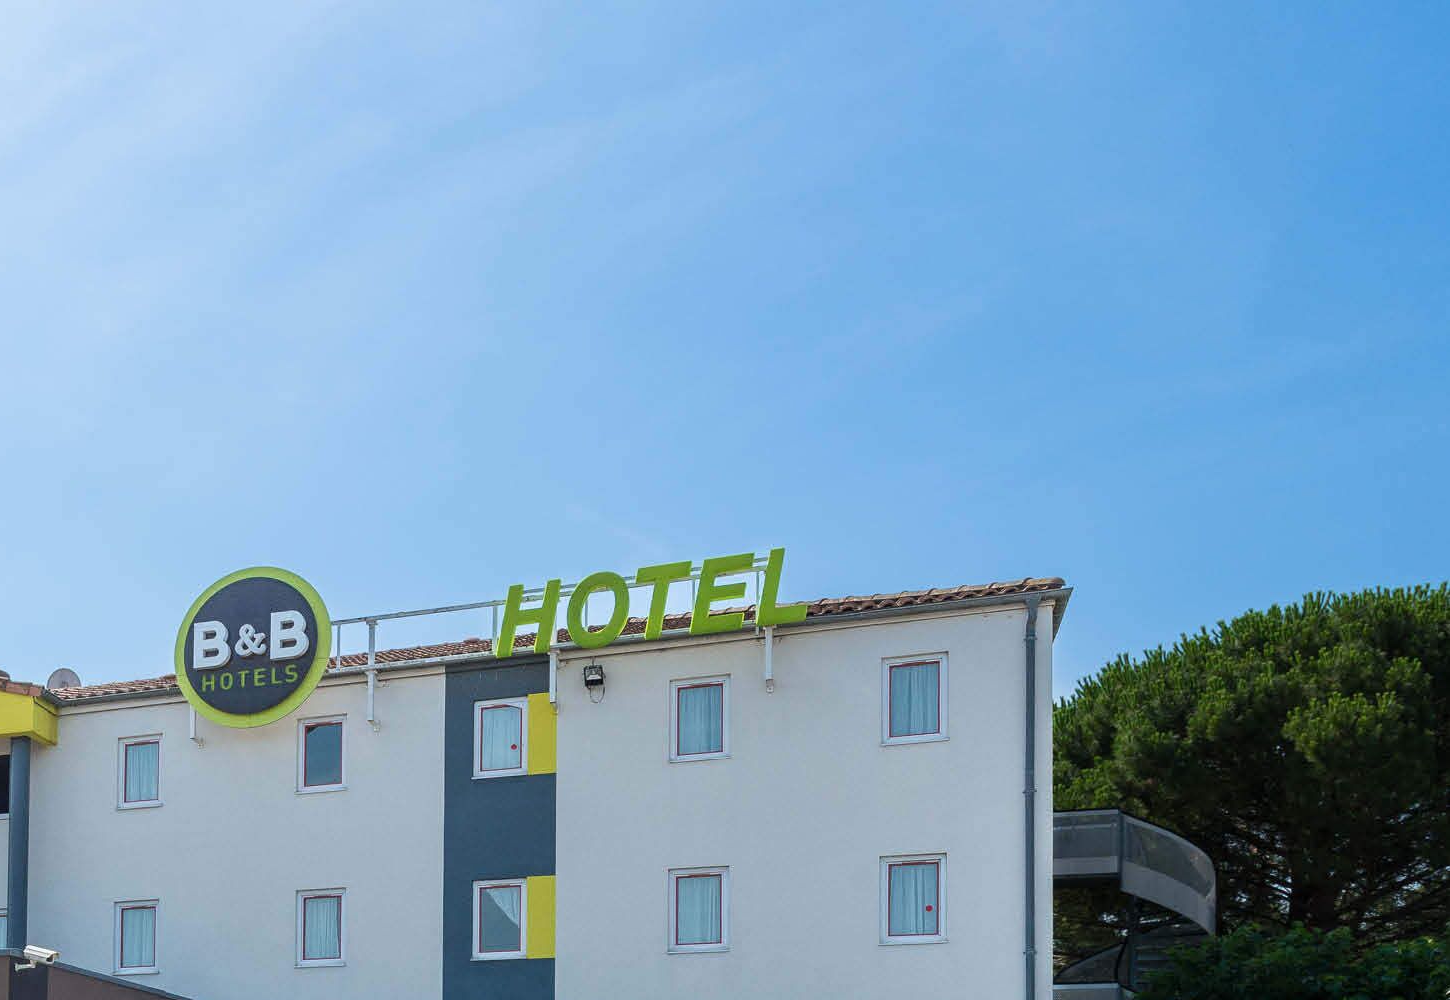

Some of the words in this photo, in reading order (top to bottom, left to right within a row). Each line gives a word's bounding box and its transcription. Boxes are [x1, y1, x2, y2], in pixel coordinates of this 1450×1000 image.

[496, 547, 808, 659] HOTEL
[192, 609, 310, 670] B&B
[201, 664, 299, 693] HOTELS
